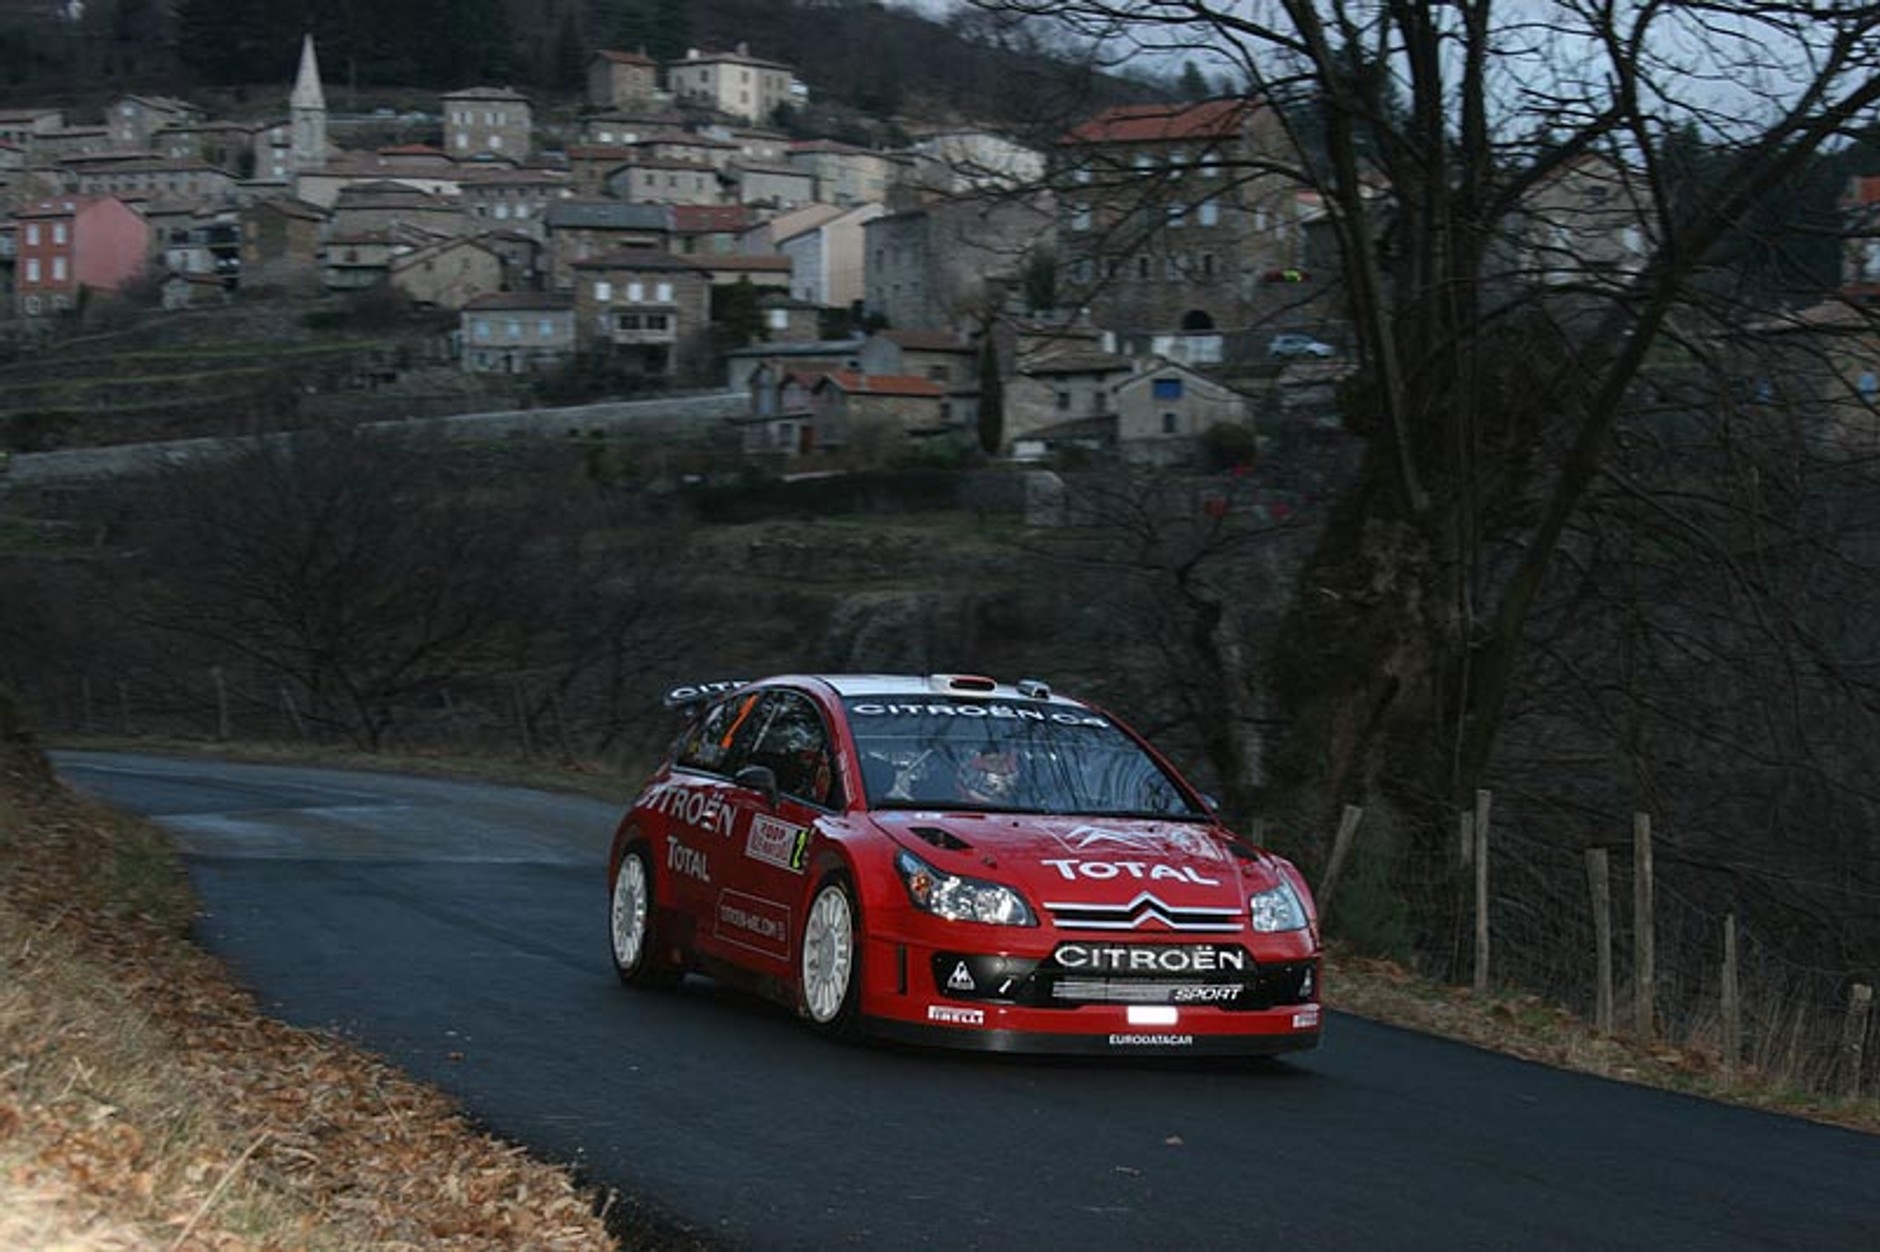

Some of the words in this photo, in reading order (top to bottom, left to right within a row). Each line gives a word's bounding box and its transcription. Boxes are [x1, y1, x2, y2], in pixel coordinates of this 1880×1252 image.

[853, 703, 1046, 721] CITROËN
[667, 834, 712, 883] TOTAL
[1041, 859, 1221, 887] TOTAL
[1054, 945, 1245, 971] CITROËN
[1174, 986, 1243, 1001] SPORT
[1108, 1034, 1193, 1045] EURODATACAR
